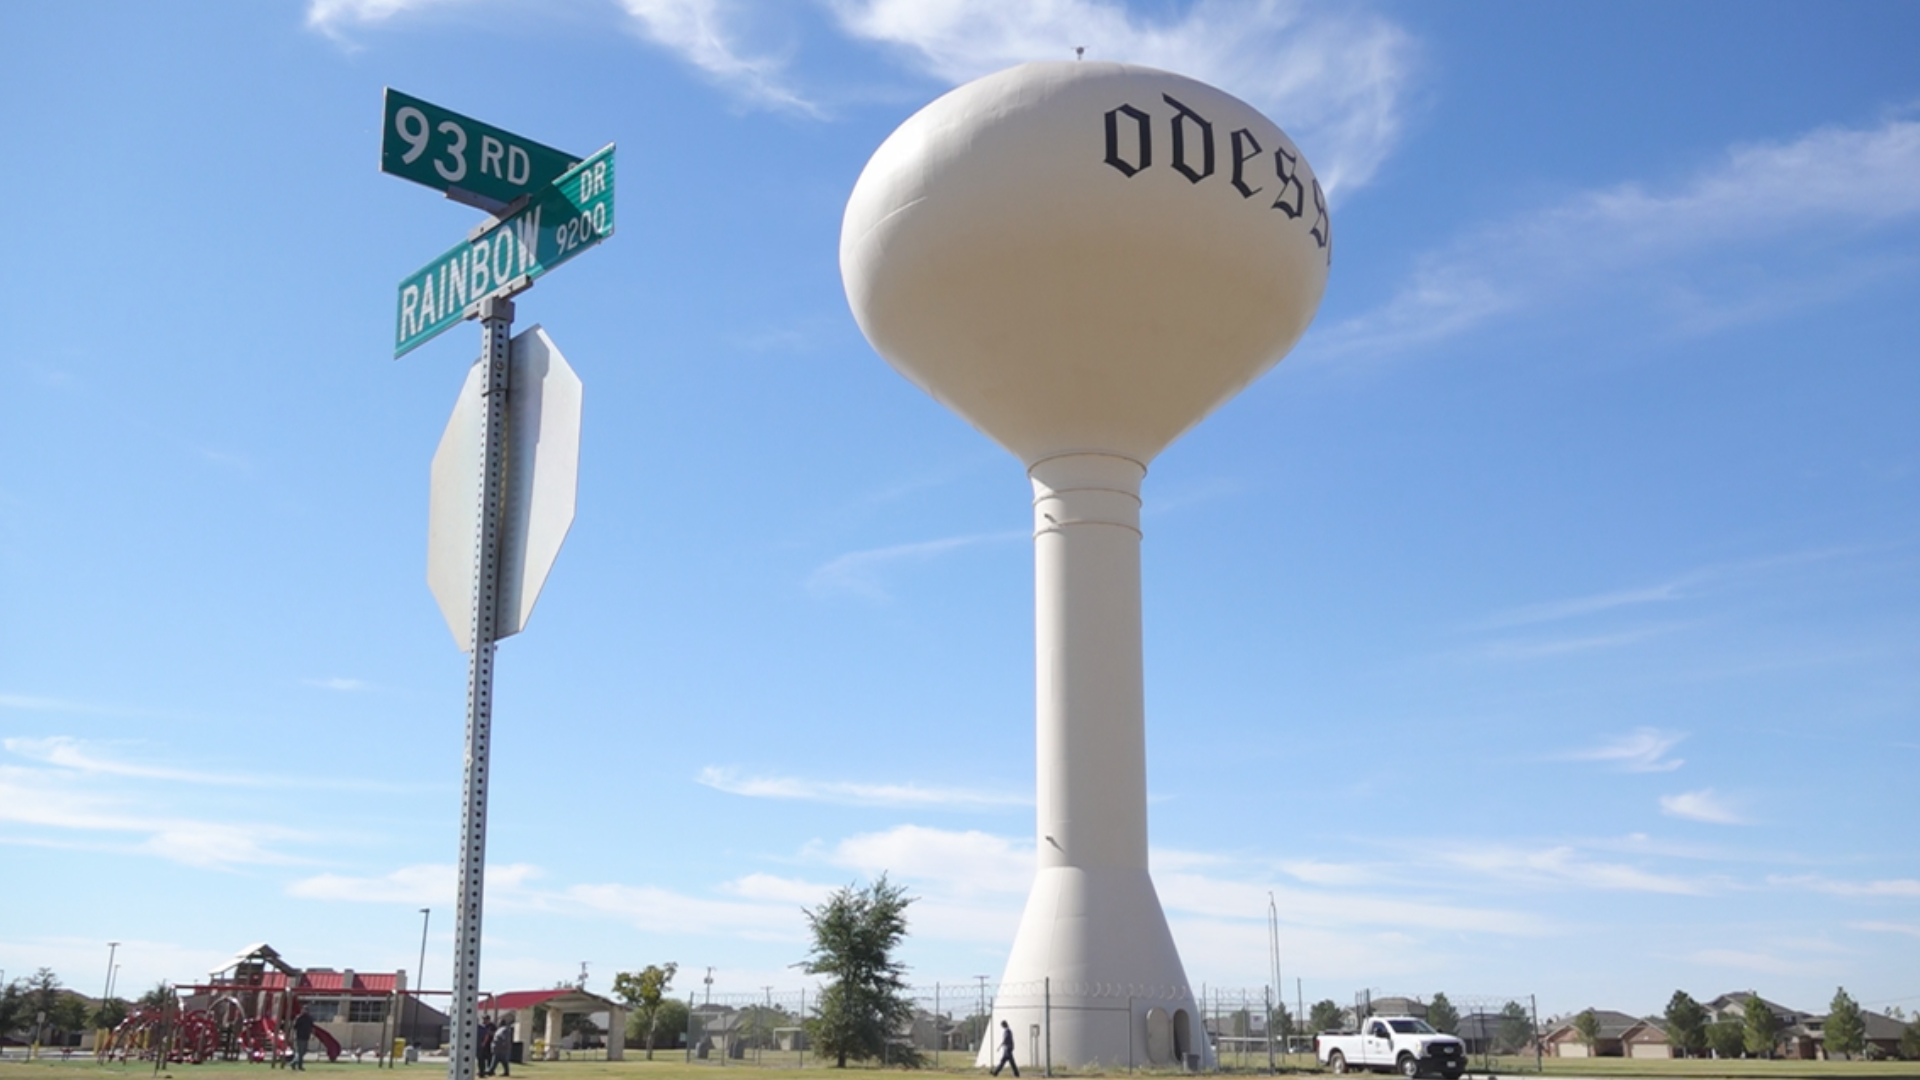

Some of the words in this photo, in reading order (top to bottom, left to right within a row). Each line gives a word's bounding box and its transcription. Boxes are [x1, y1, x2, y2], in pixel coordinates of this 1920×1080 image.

[399, 205, 542, 342] RAINBOW
[580, 160, 607, 204] DR
[556, 202, 606, 255] 9200
[1103, 92, 1331, 267] odess
